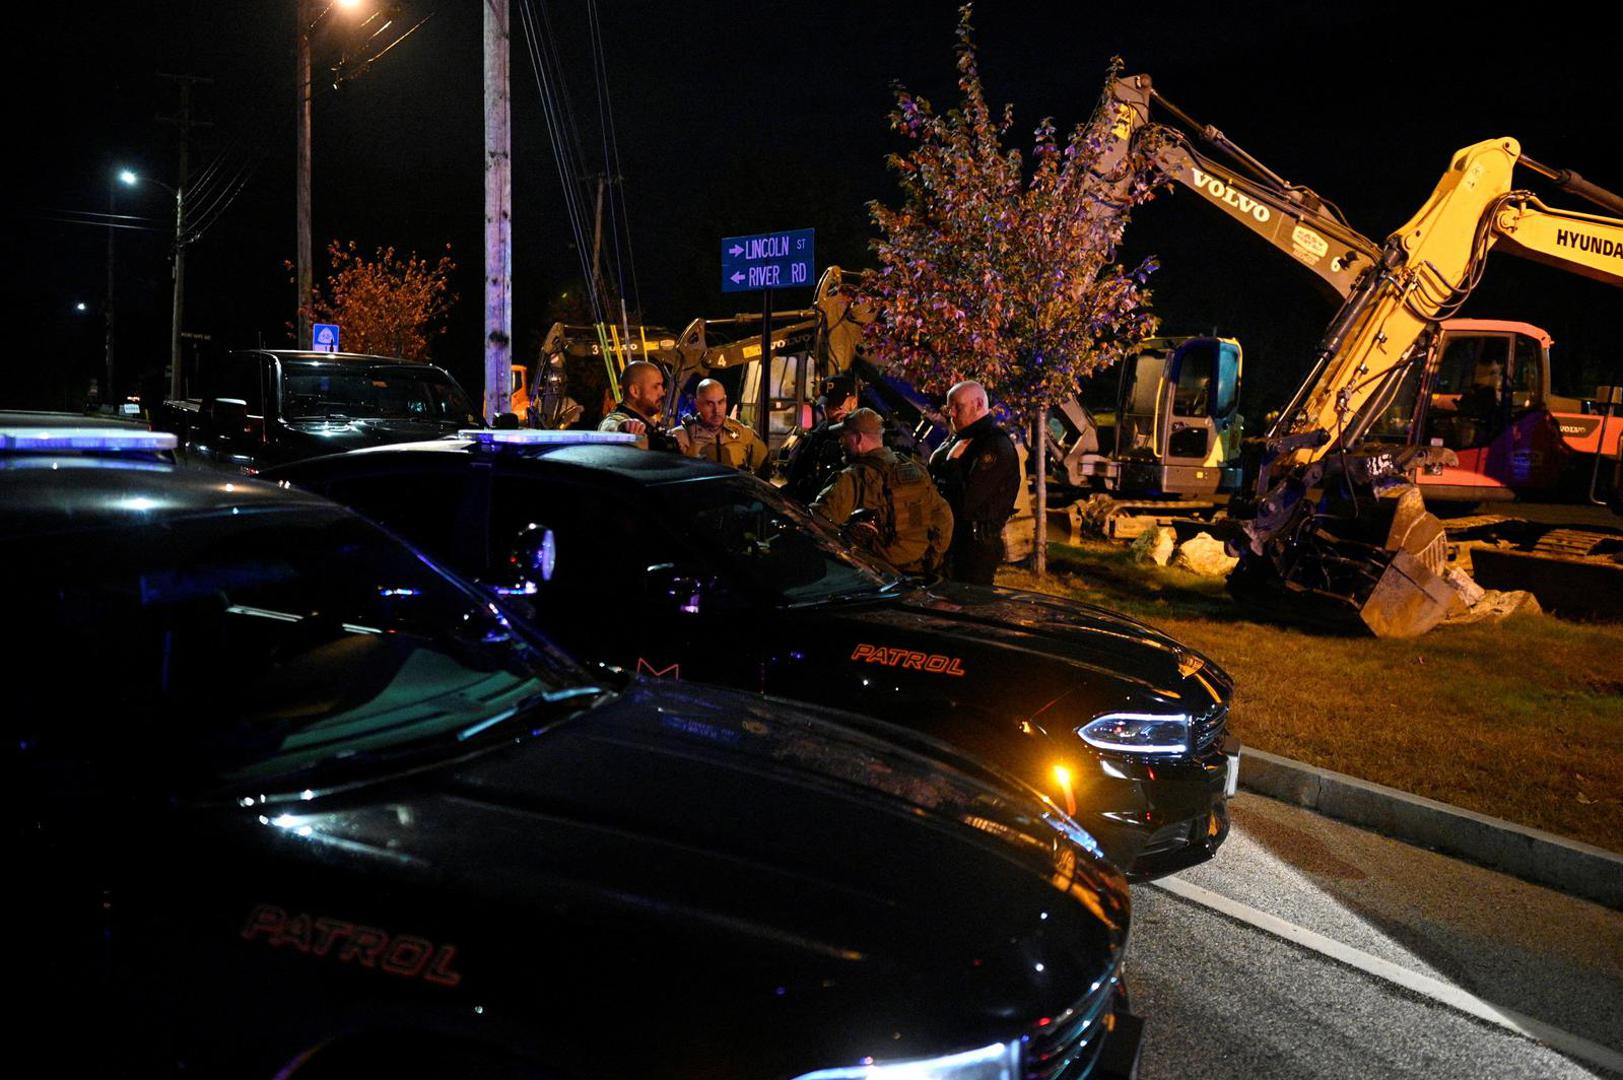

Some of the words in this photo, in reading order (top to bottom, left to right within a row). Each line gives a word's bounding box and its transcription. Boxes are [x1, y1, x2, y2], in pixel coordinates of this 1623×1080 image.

[1191, 168, 1270, 222] VOLVO
[745, 235, 789, 260] LINCOLN
[796, 238, 806, 250] ST
[748, 265, 780, 287] RIVER
[791, 262, 807, 283] RD
[1330, 256, 1342, 272] 6
[591, 344, 600, 356] 3
[717, 353, 727, 367] 4
[1559, 425, 1586, 433] VOLVO
[850, 643, 966, 676] PATROL
[240, 902, 464, 988] PATROL
